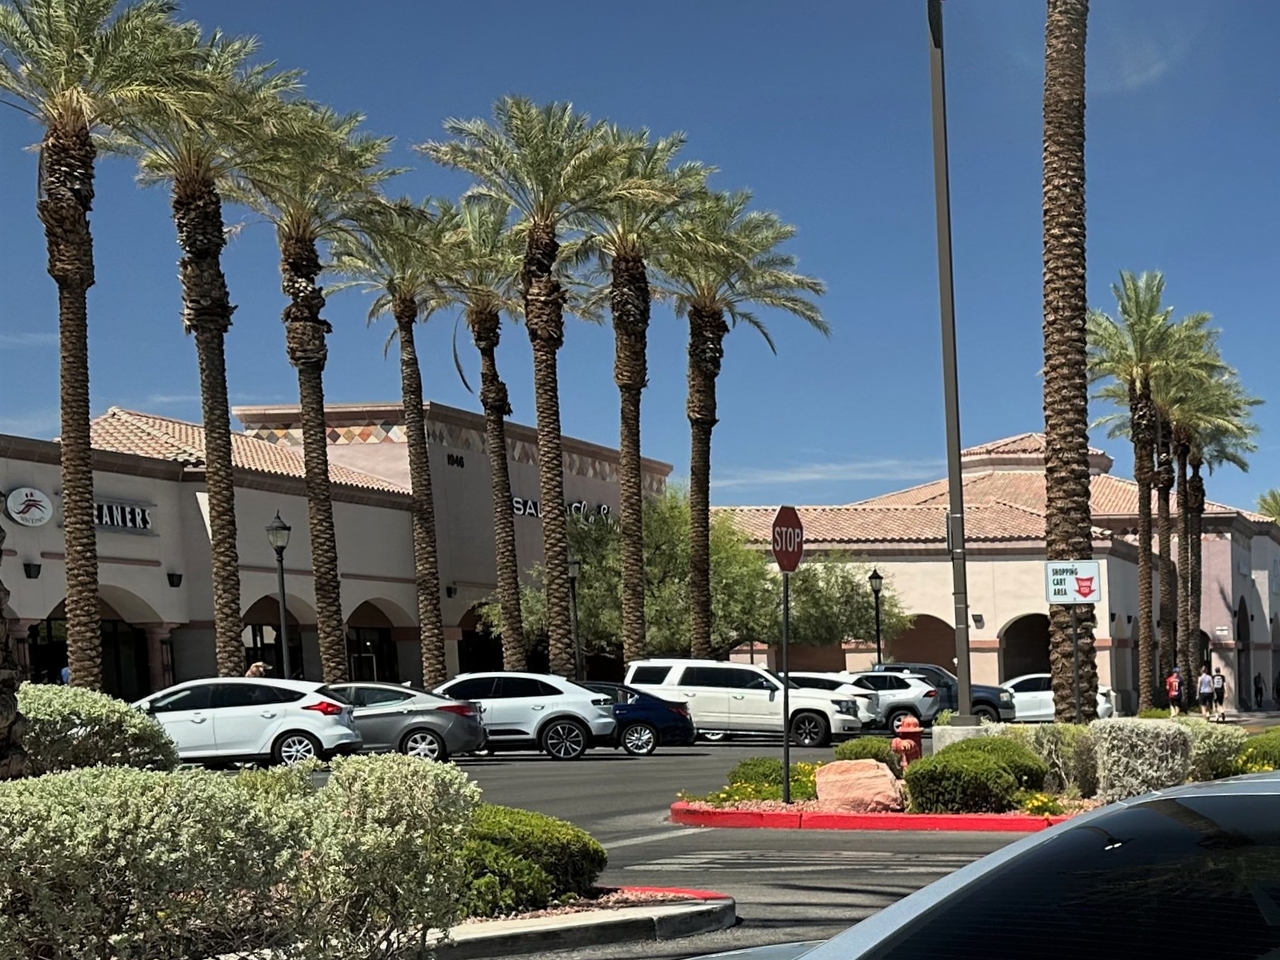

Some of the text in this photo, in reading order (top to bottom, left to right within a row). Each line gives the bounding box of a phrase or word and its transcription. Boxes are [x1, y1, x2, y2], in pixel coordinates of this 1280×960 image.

[93, 503, 152, 529] EANERS
[774, 526, 802, 552] STOP
[1052, 568, 1078, 576] SHOPPING
[1052, 578, 1066, 586] CART
[1053, 588, 1068, 596] AREA
